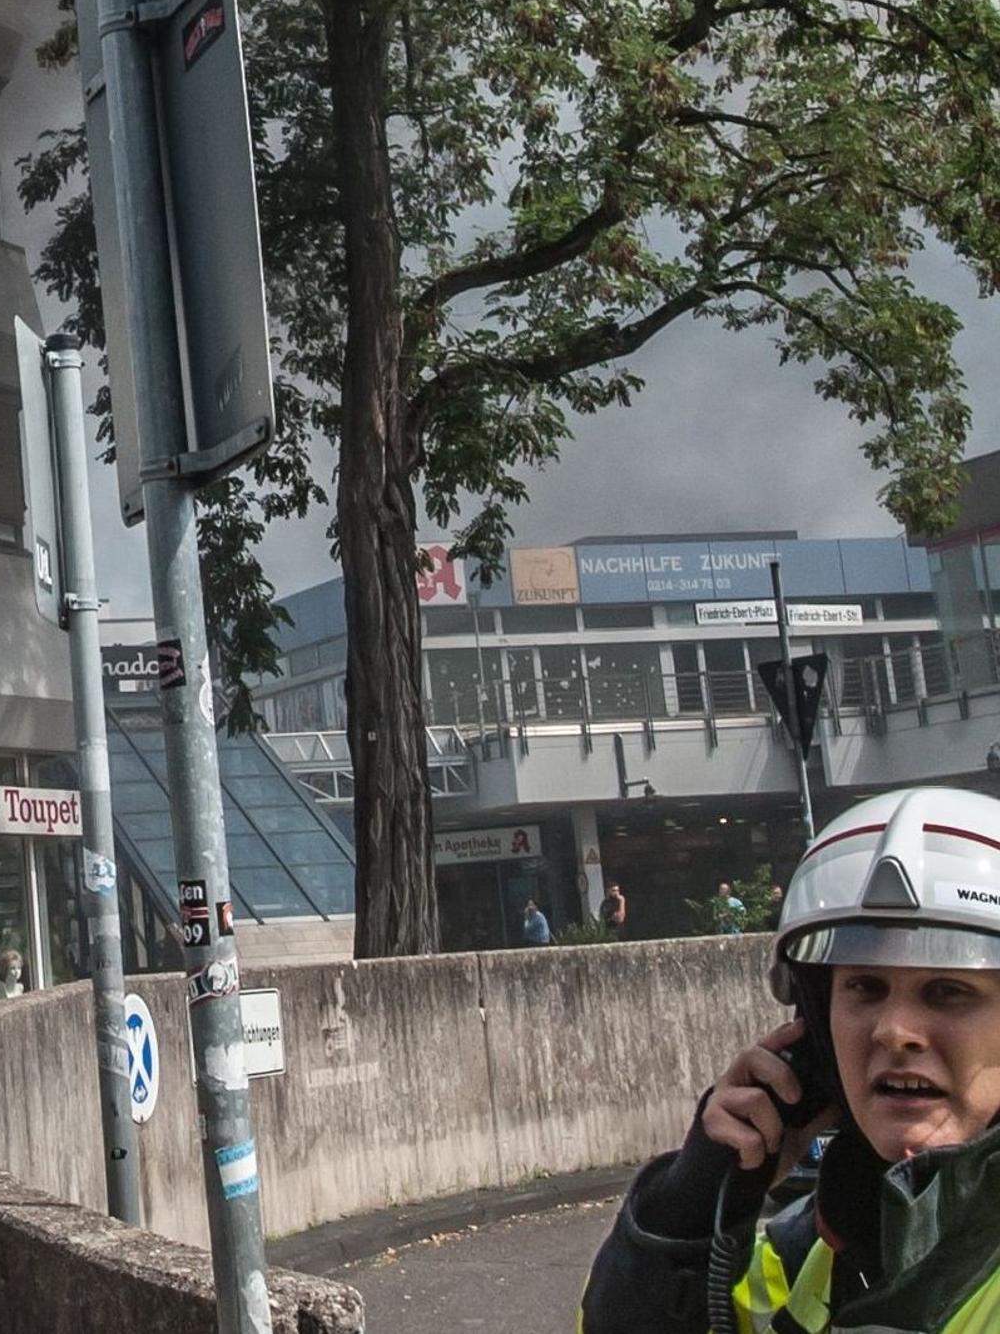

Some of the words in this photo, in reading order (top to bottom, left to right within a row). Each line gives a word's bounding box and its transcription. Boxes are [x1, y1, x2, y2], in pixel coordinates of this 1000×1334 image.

[581, 555, 683, 574] NACHHILFE
[700, 553, 782, 570] ZUKUNFT
[516, 588, 576, 602] ZUKUNFT
[699, 607, 774, 620] Friedrich-Ebert-Platz
[789, 609, 858, 622] Friedrich-Ebert-Str.
[4, 789, 80, 832] Toupet
[957, 889, 1000, 905] WAGN
[242, 1024, 279, 1047] ichtungen
